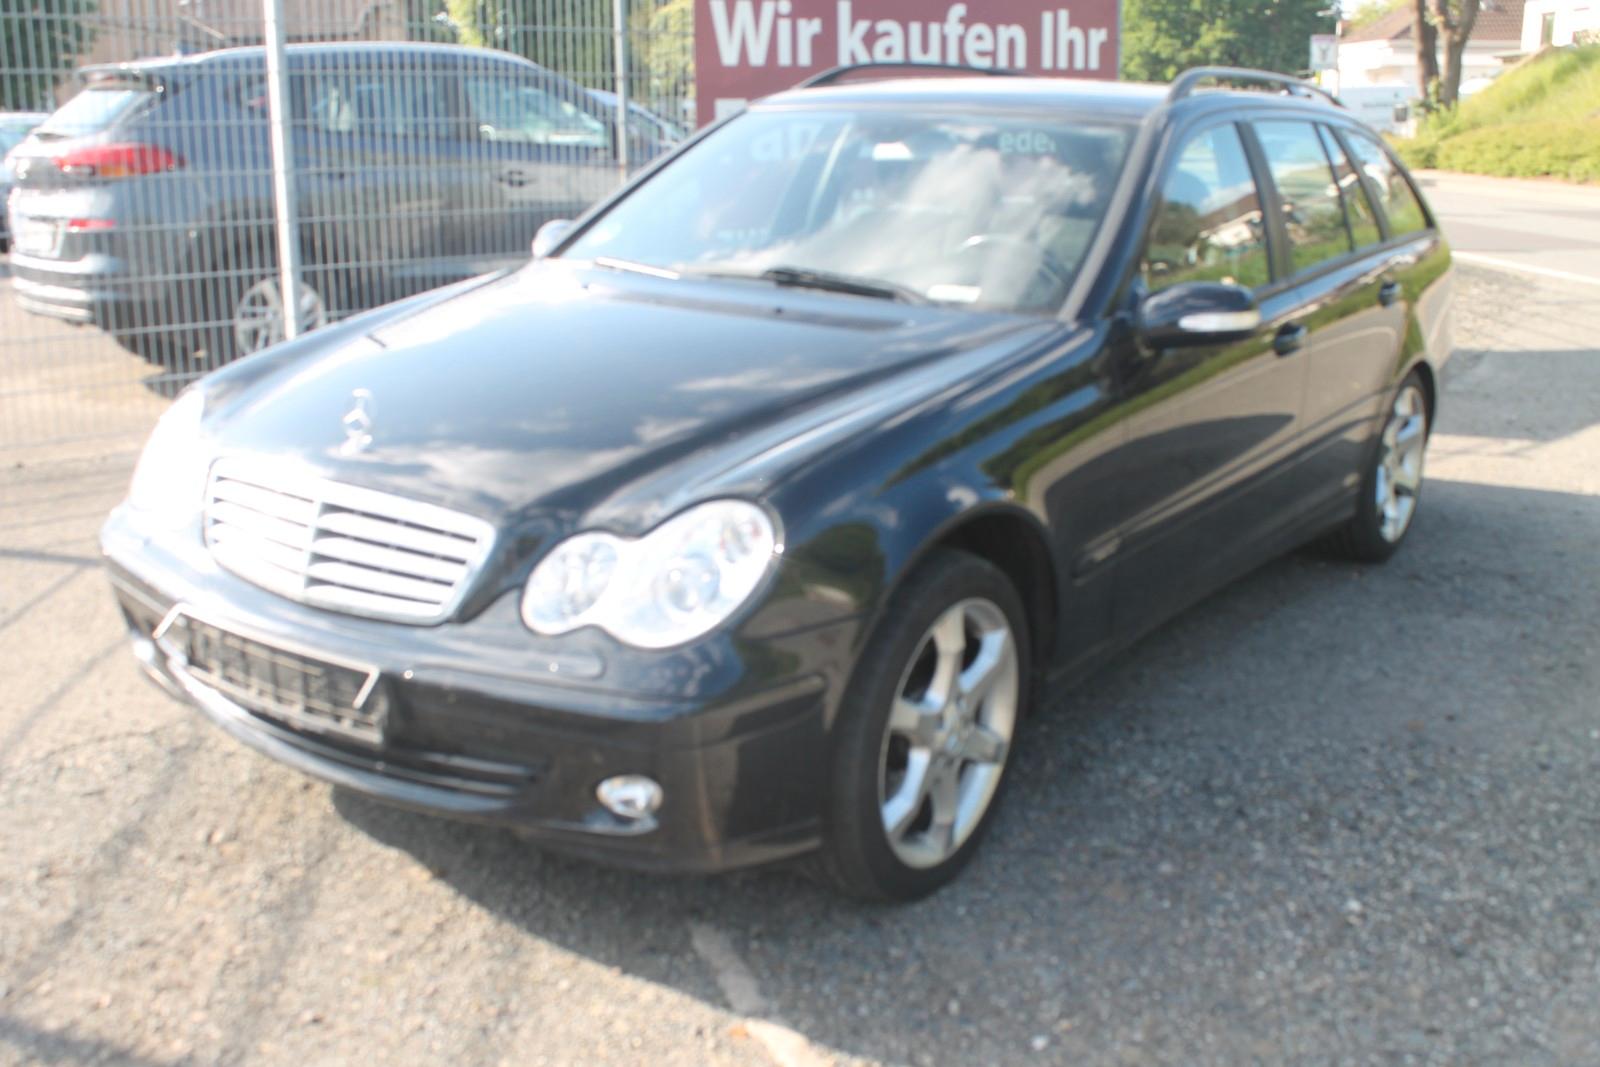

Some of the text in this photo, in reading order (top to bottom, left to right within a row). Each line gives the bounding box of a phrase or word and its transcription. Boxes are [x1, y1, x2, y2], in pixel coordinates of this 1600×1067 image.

[709, 0, 1107, 71] Wir kaufen Ihr
